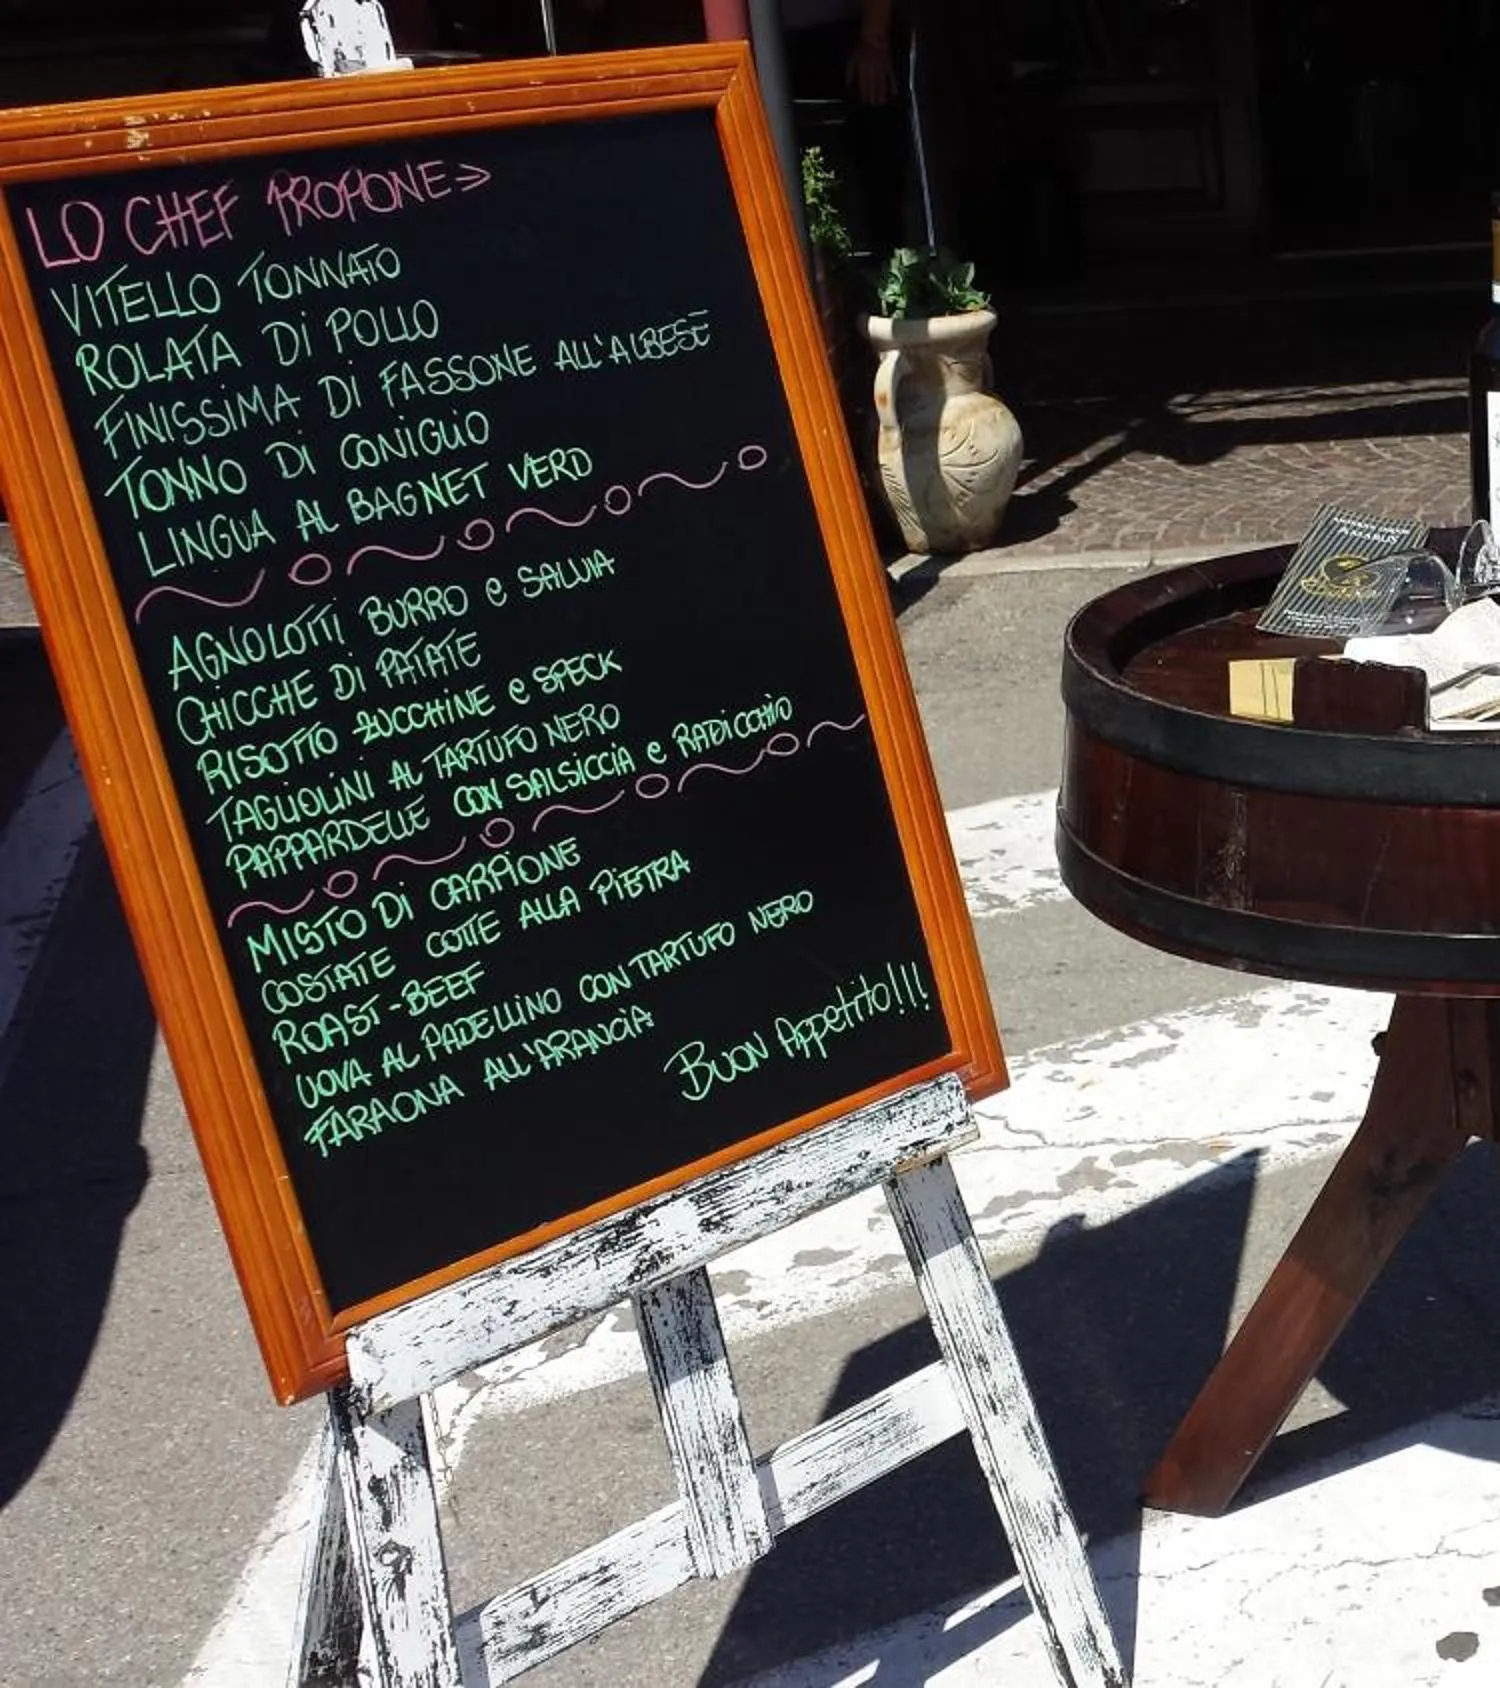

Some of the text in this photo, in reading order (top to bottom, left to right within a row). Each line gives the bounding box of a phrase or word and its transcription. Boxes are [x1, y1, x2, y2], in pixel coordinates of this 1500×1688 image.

[26, 201, 105, 268] LO
[125, 180, 239, 256] CHEF
[50, 243, 401, 337] VITELLO TONNATO
[75, 324, 242, 395] ROLATA
[325, 300, 439, 353] POLLO
[378, 343, 537, 407] FASSONE
[104, 455, 247, 519] TONNO
[138, 447, 594, 578] LINGUA AL BAGNET VERD
[168, 597, 346, 691] AGNOLOTTI
[359, 585, 469, 638] BURRO
[517, 548, 617, 599] SALVIA
[374, 627, 482, 690] PATATE
[196, 721, 339, 796] RISOTTO
[530, 648, 624, 694] SPECK
[387, 759, 423, 793] AL
[420, 725, 538, 780] TARTUFO
[546, 702, 620, 749] NERO
[226, 794, 432, 890] PAPPARDELLE
[453, 776, 503, 818] CON
[246, 904, 367, 976] MISTO
[262, 945, 397, 1015] COSTATE
[425, 909, 502, 958] COTTE
[518, 885, 582, 931] ALLA
[295, 1057, 373, 1109] UOVA
[381, 1041, 421, 1079] AL
[578, 965, 633, 1003] CON
[627, 921, 736, 980] TARTUFO
[747, 889, 815, 935] NERO
[304, 1074, 465, 1158] FARAONA
